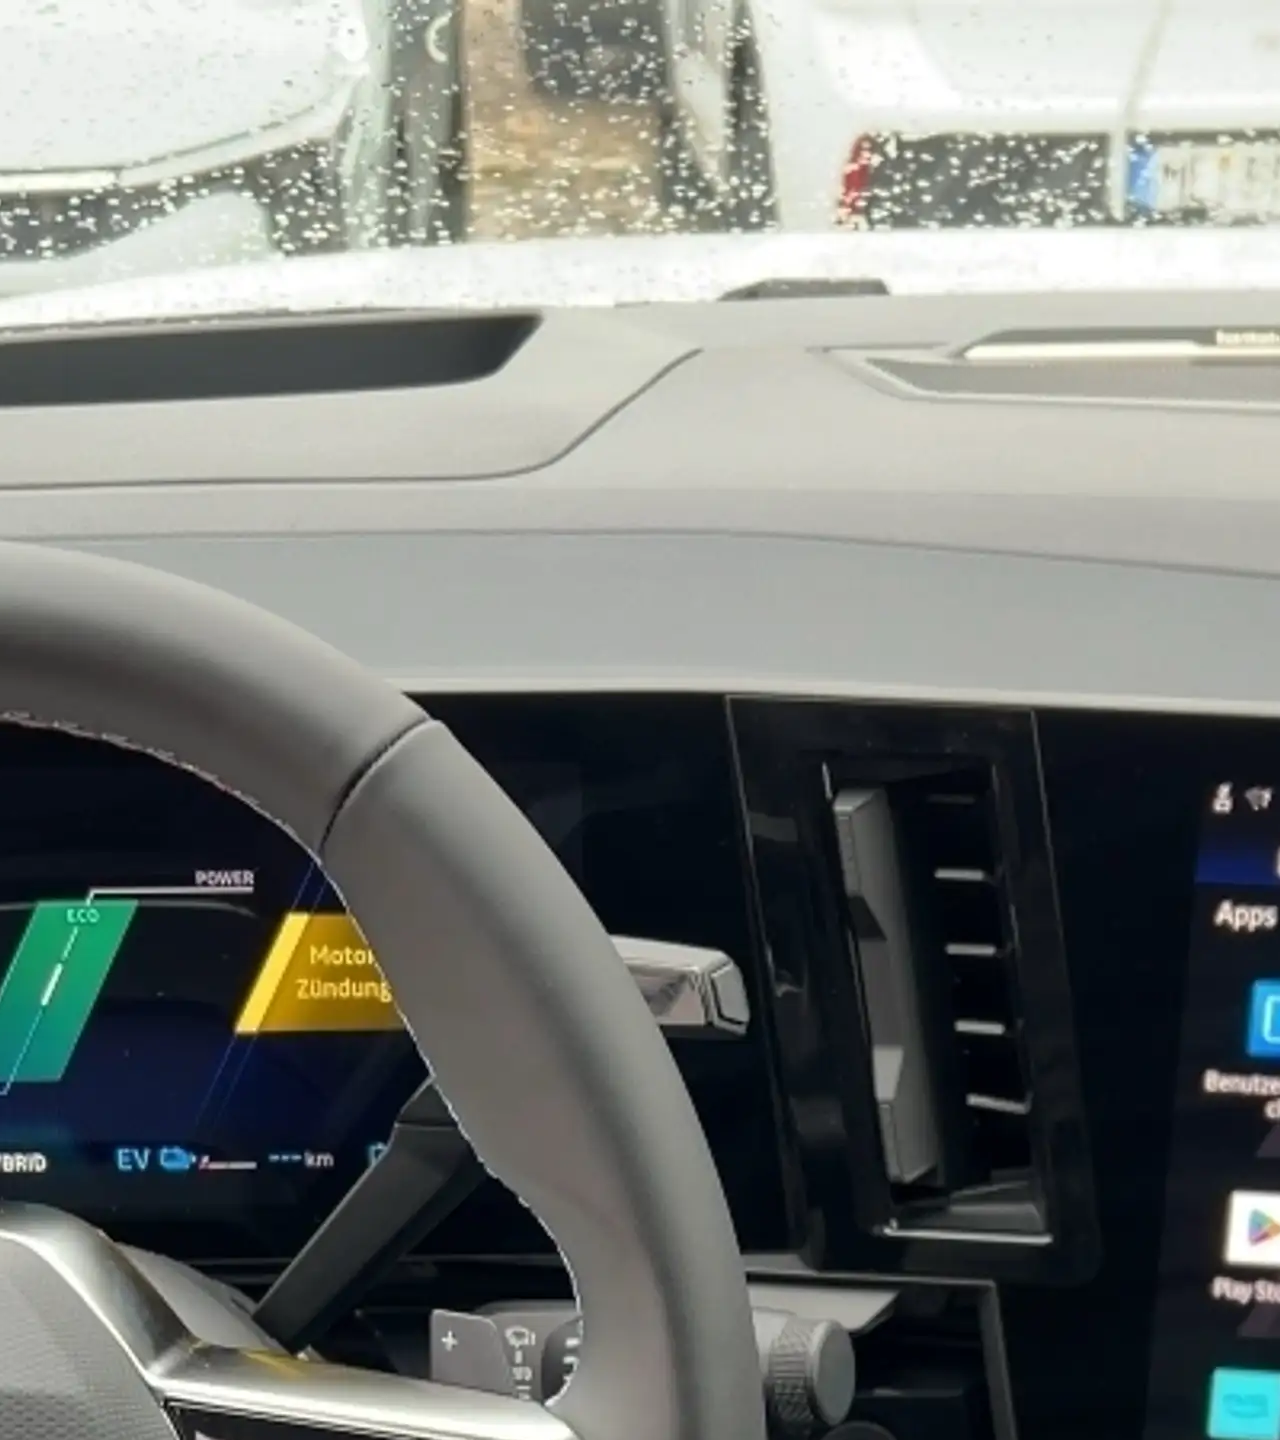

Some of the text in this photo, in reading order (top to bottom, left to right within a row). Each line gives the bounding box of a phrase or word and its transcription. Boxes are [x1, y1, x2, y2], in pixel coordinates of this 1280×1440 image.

[195, 871, 255, 886] POWER
[65, 908, 100, 925] ECO
[1214, 900, 1279, 931] Apps
[116, 1149, 151, 1171] EV
